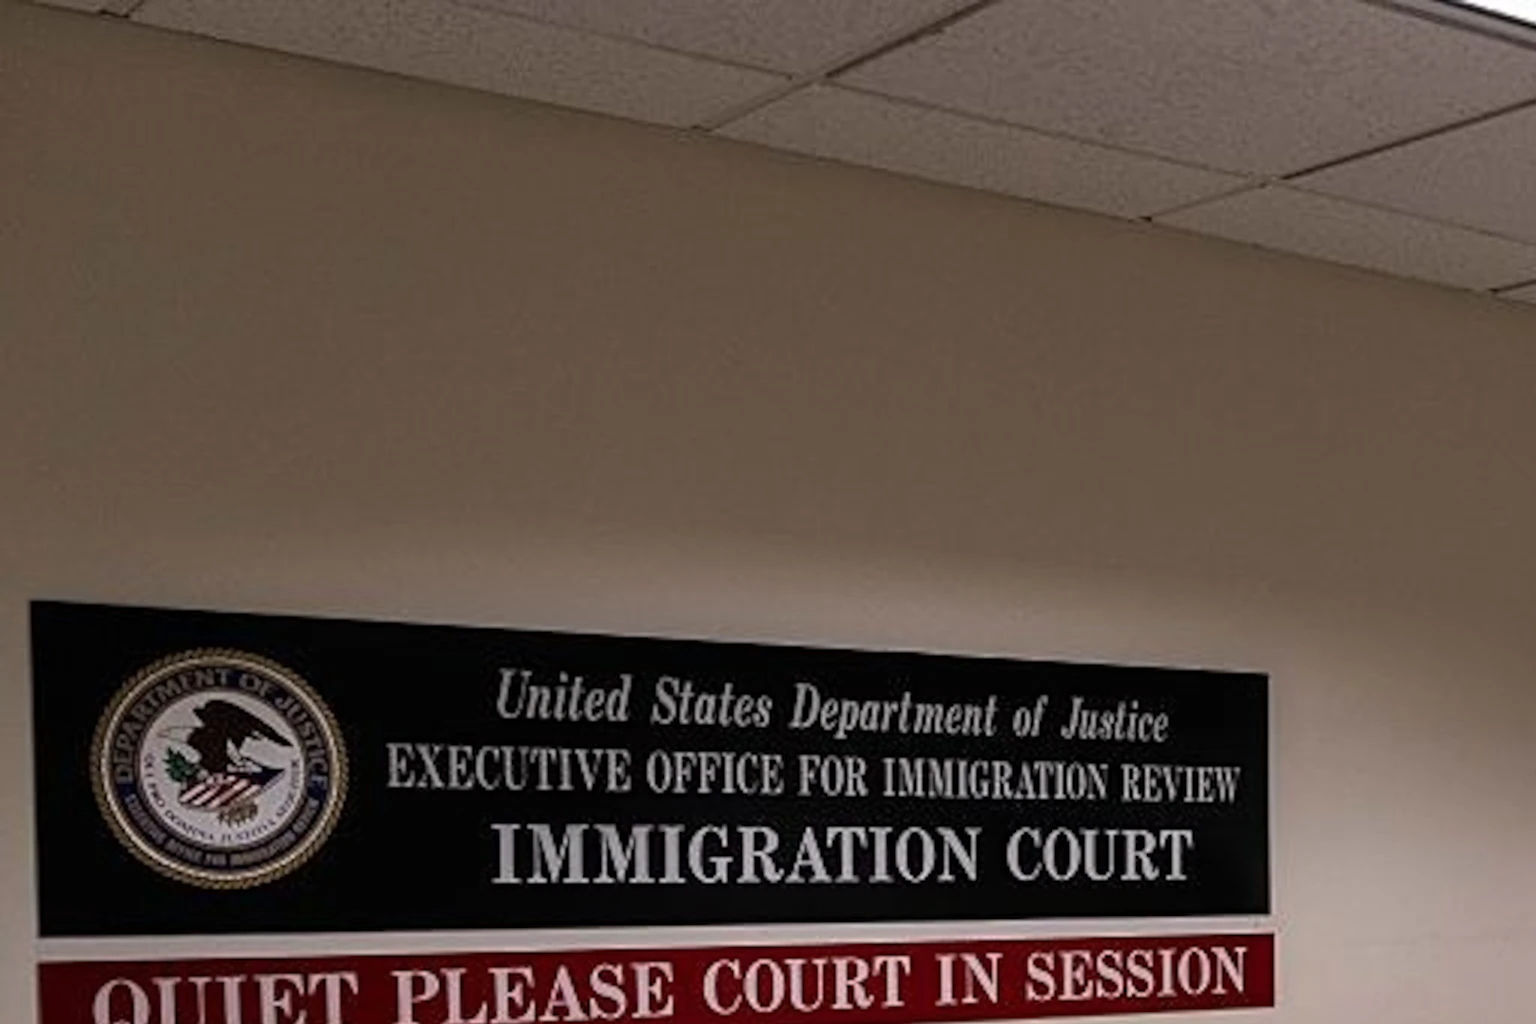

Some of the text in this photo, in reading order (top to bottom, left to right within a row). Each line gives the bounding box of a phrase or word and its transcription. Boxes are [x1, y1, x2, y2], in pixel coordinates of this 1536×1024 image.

[115, 667, 229, 783] DEPARTMENT
[238, 671, 273, 698] OF
[274, 695, 329, 790] JUSTICE
[496, 668, 1169, 743] United States Department of Justice
[386, 743, 1241, 803] EXECUTIVE OFFICE FOR IMMIGRATION REVIEW
[491, 823, 1193, 884] IMMIGRATION COURT
[703, 955, 911, 1015] COURT
[936, 952, 1003, 1006] IN
[1026, 946, 1247, 1001] SESSION
